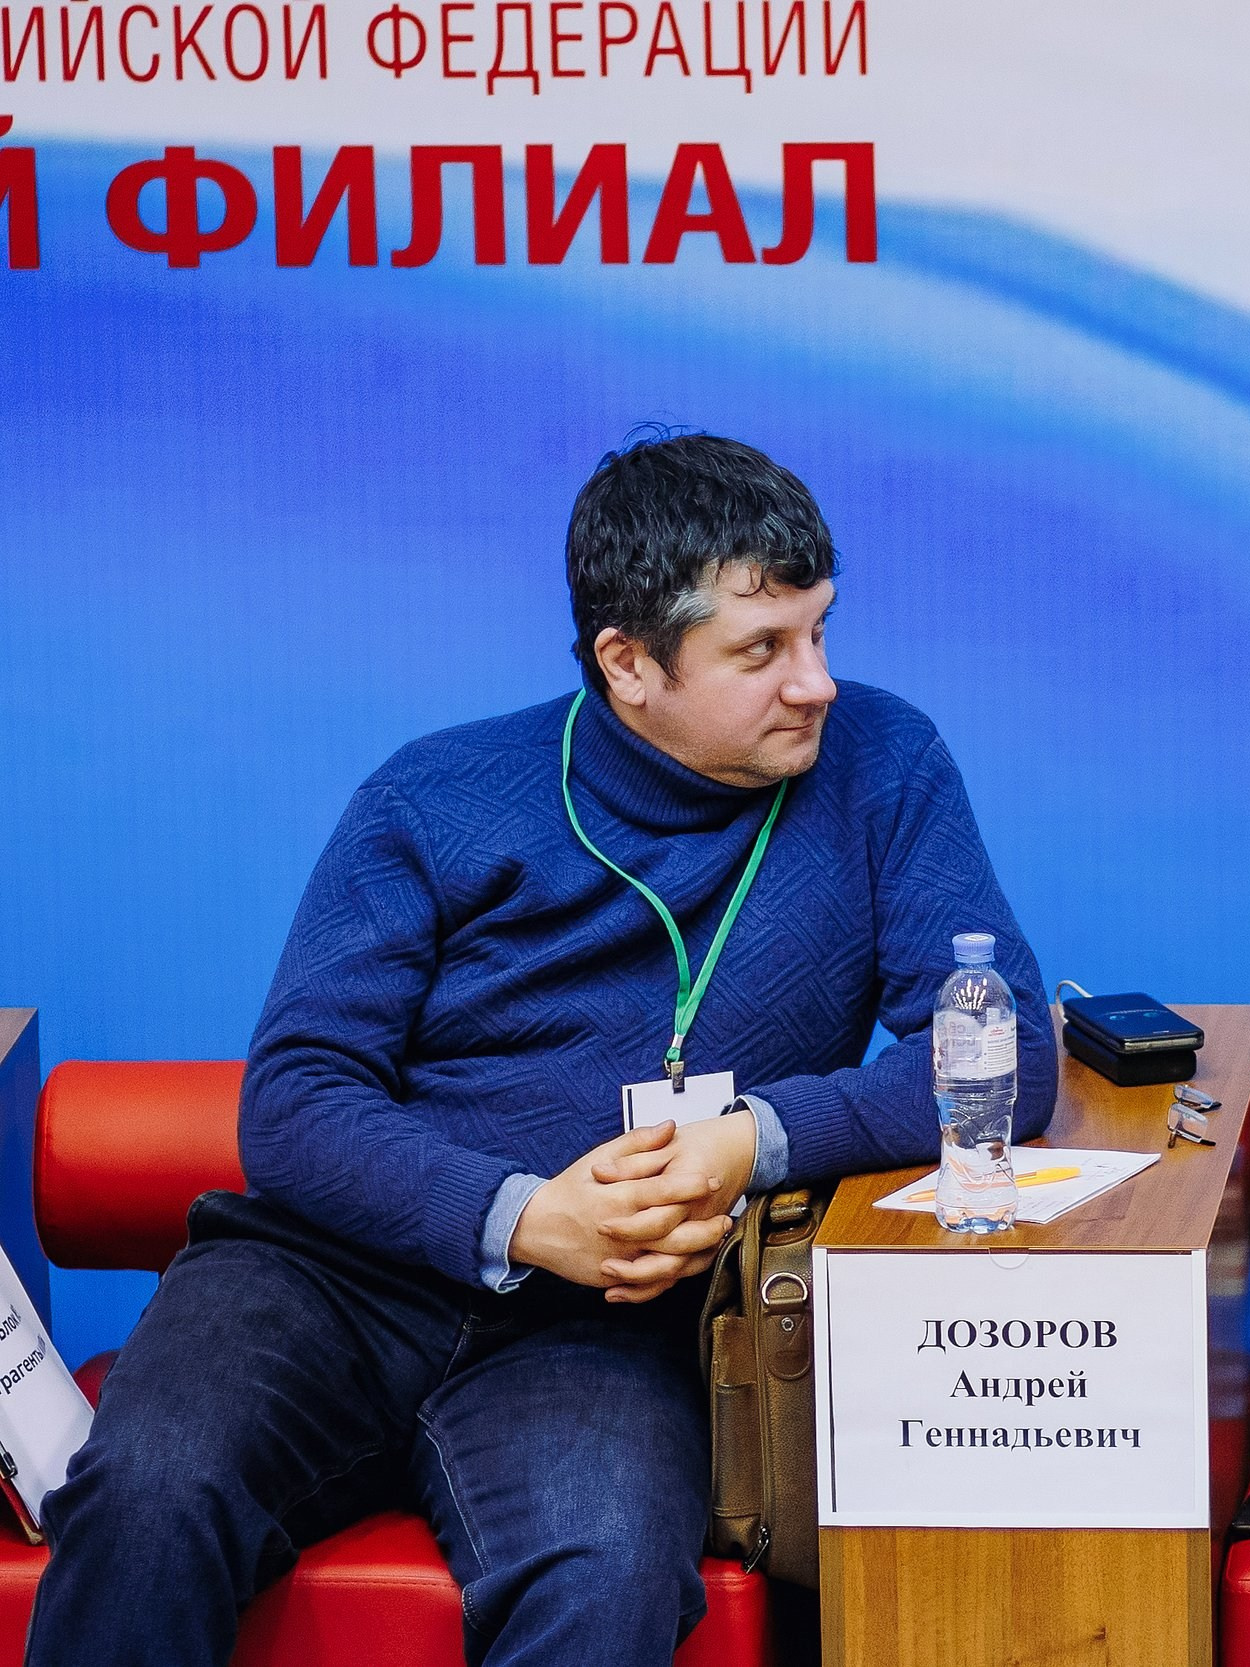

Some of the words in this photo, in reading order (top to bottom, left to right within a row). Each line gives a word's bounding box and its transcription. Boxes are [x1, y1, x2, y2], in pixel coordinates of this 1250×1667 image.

[366, 0, 869, 96] ФЕДЕРАЦИИ
[105, 141, 879, 269] ФИЛИАЛ
[917, 1319, 1118, 1354] ДОЗОРОВ
[949, 1369, 1088, 1407] Андрей
[897, 1419, 1142, 1452] Геннадьевич
